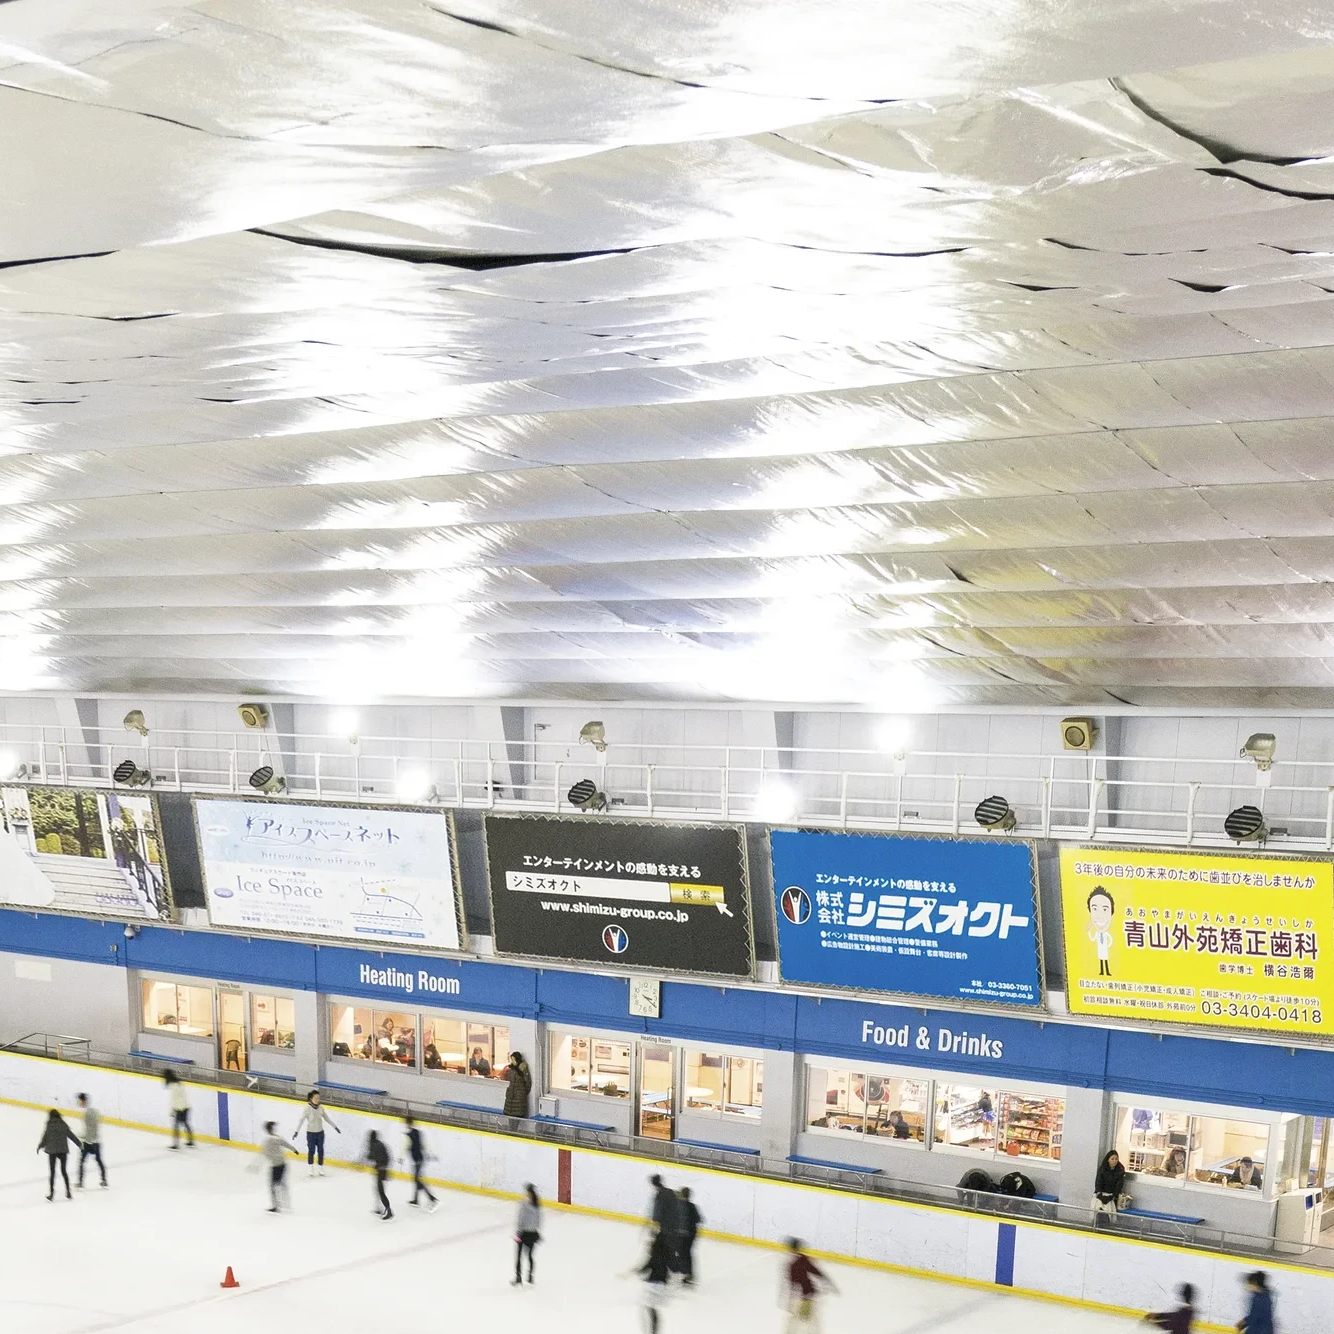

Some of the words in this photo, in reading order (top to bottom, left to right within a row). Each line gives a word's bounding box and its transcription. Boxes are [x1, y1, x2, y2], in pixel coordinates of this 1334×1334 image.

[523, 856, 701, 879] エンターテインメントの感動を支える
[1075, 862, 1316, 889] 3年後の自分の未来のために歯並びを治しませんか
[236, 875, 262, 893] Ice
[269, 878, 323, 902] Space
[513, 876, 581, 892] シミズオクト
[816, 873, 957, 894] エンターテインメントの感動を支える
[541, 901, 688, 923] www.shimizu-group.co.jp
[847, 892, 1029, 939] シミズオクト
[1124, 921, 1318, 960] 青山外苑矯正歯科
[360, 964, 414, 993] Heating
[418, 969, 460, 995] Room
[1219, 964, 1254, 976] 歯学博士
[959, 987, 1034, 999] www.shimizu-group.co.jp
[1201, 1000, 1322, 1024] 03-3404-0418
[641, 1035, 658, 1044] Heating
[659, 1036, 672, 1044] Room
[862, 1020, 909, 1048] Food
[915, 1026, 931, 1049] &
[938, 1027, 1003, 1059] Drinks
